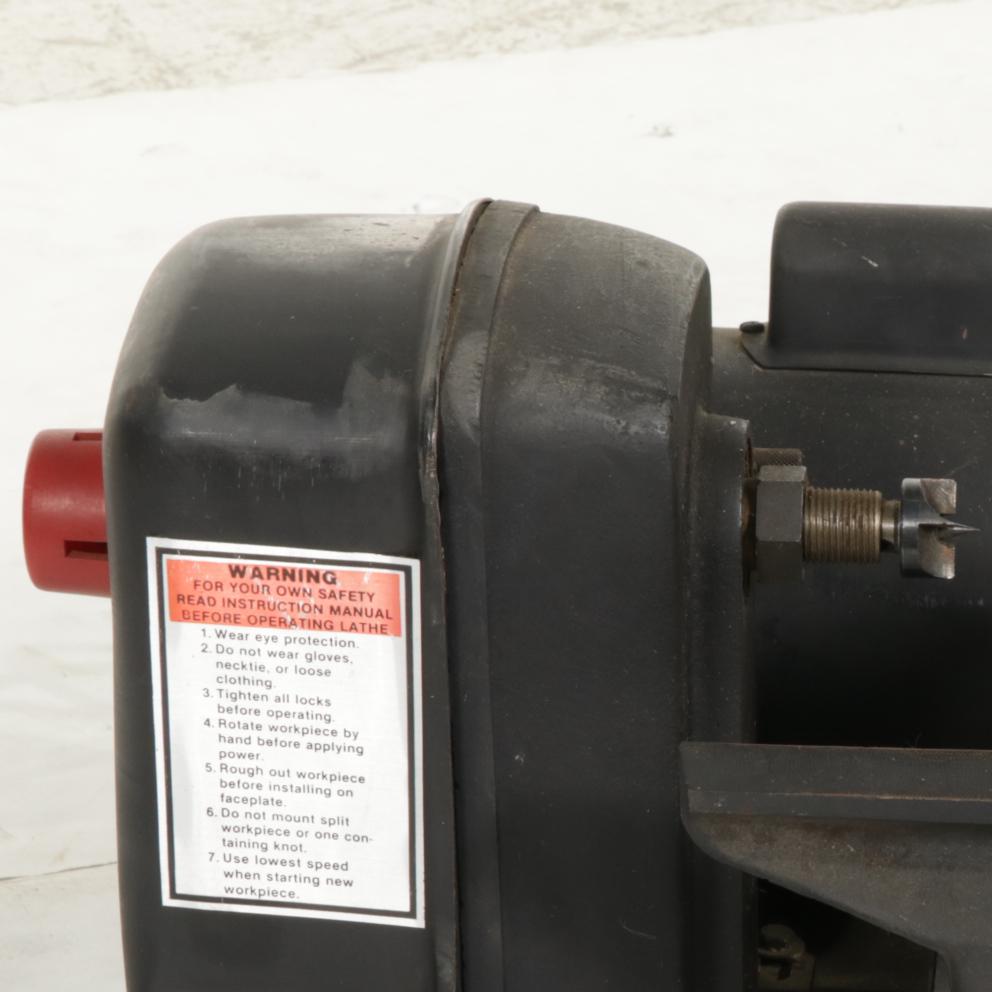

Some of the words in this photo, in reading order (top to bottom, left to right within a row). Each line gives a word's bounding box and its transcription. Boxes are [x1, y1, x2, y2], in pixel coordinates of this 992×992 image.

[228, 564, 338, 585] WARNING
[194, 579, 224, 592] FOR
[230, 582, 270, 594] YOUR
[276, 586, 312, 598] OWN
[318, 588, 375, 602] SAFETY
[177, 594, 216, 608] READ
[222, 597, 323, 614] INSTRUCTION
[329, 605, 392, 620] MANUAL
[182, 610, 241, 624] BEFORE
[248, 614, 334, 631] OPERATING
[340, 620, 388, 634] LATHE
[202, 628, 211, 638] 1.
[214, 628, 249, 641] Wear
[255, 634, 278, 645] eye
[284, 634, 359, 648] protection.
[201, 644, 212, 654] 2.
[216, 644, 234, 656] Do
[240, 646, 261, 657] not
[268, 650, 299, 660] wear
[276, 664, 289, 674] or
[294, 666, 332, 677] loose
[216, 674, 276, 688] clothing.
[202, 688, 213, 698] 3.
[217, 688, 268, 703] Tighten
[274, 692, 290, 703] all
[296, 694, 332, 707] locks
[218, 704, 260, 717] before
[266, 706, 335, 723] operating.
[204, 718, 214, 728] 4.
[218, 718, 262, 732] Rotate
[268, 724, 338, 737] workpiece
[344, 727, 359, 740] by
[218, 734, 252, 746] hand
[257, 736, 300, 748] before
[306, 740, 364, 756] applying
[218, 750, 264, 762] power.
[205, 762, 216, 773] 5.
[220, 763, 263, 778] Rough
[269, 768, 291, 778] out
[296, 770, 366, 784] workpiece
[220, 778, 263, 791] before
[268, 782, 332, 798] installing
[337, 788, 353, 798] on
[220, 794, 287, 808] faceplate.
[206, 808, 217, 818] 6.
[221, 808, 239, 818] Do
[244, 810, 266, 820] not
[272, 812, 315, 824] mount
[320, 816, 350, 827] split
[221, 823, 290, 837] workpiece
[296, 828, 309, 838] or
[314, 830, 339, 840] one
[344, 832, 373, 843] con-
[222, 838, 268, 852] taining
[274, 841, 307, 853] knot.
[208, 852, 219, 862] 7.
[223, 853, 249, 864] Use
[254, 855, 301, 868] lowest
[306, 859, 349, 872] speed
[224, 869, 260, 881] when
[266, 872, 320, 886] starting
[326, 877, 353, 887] new
[224, 885, 300, 899] workpiece.
